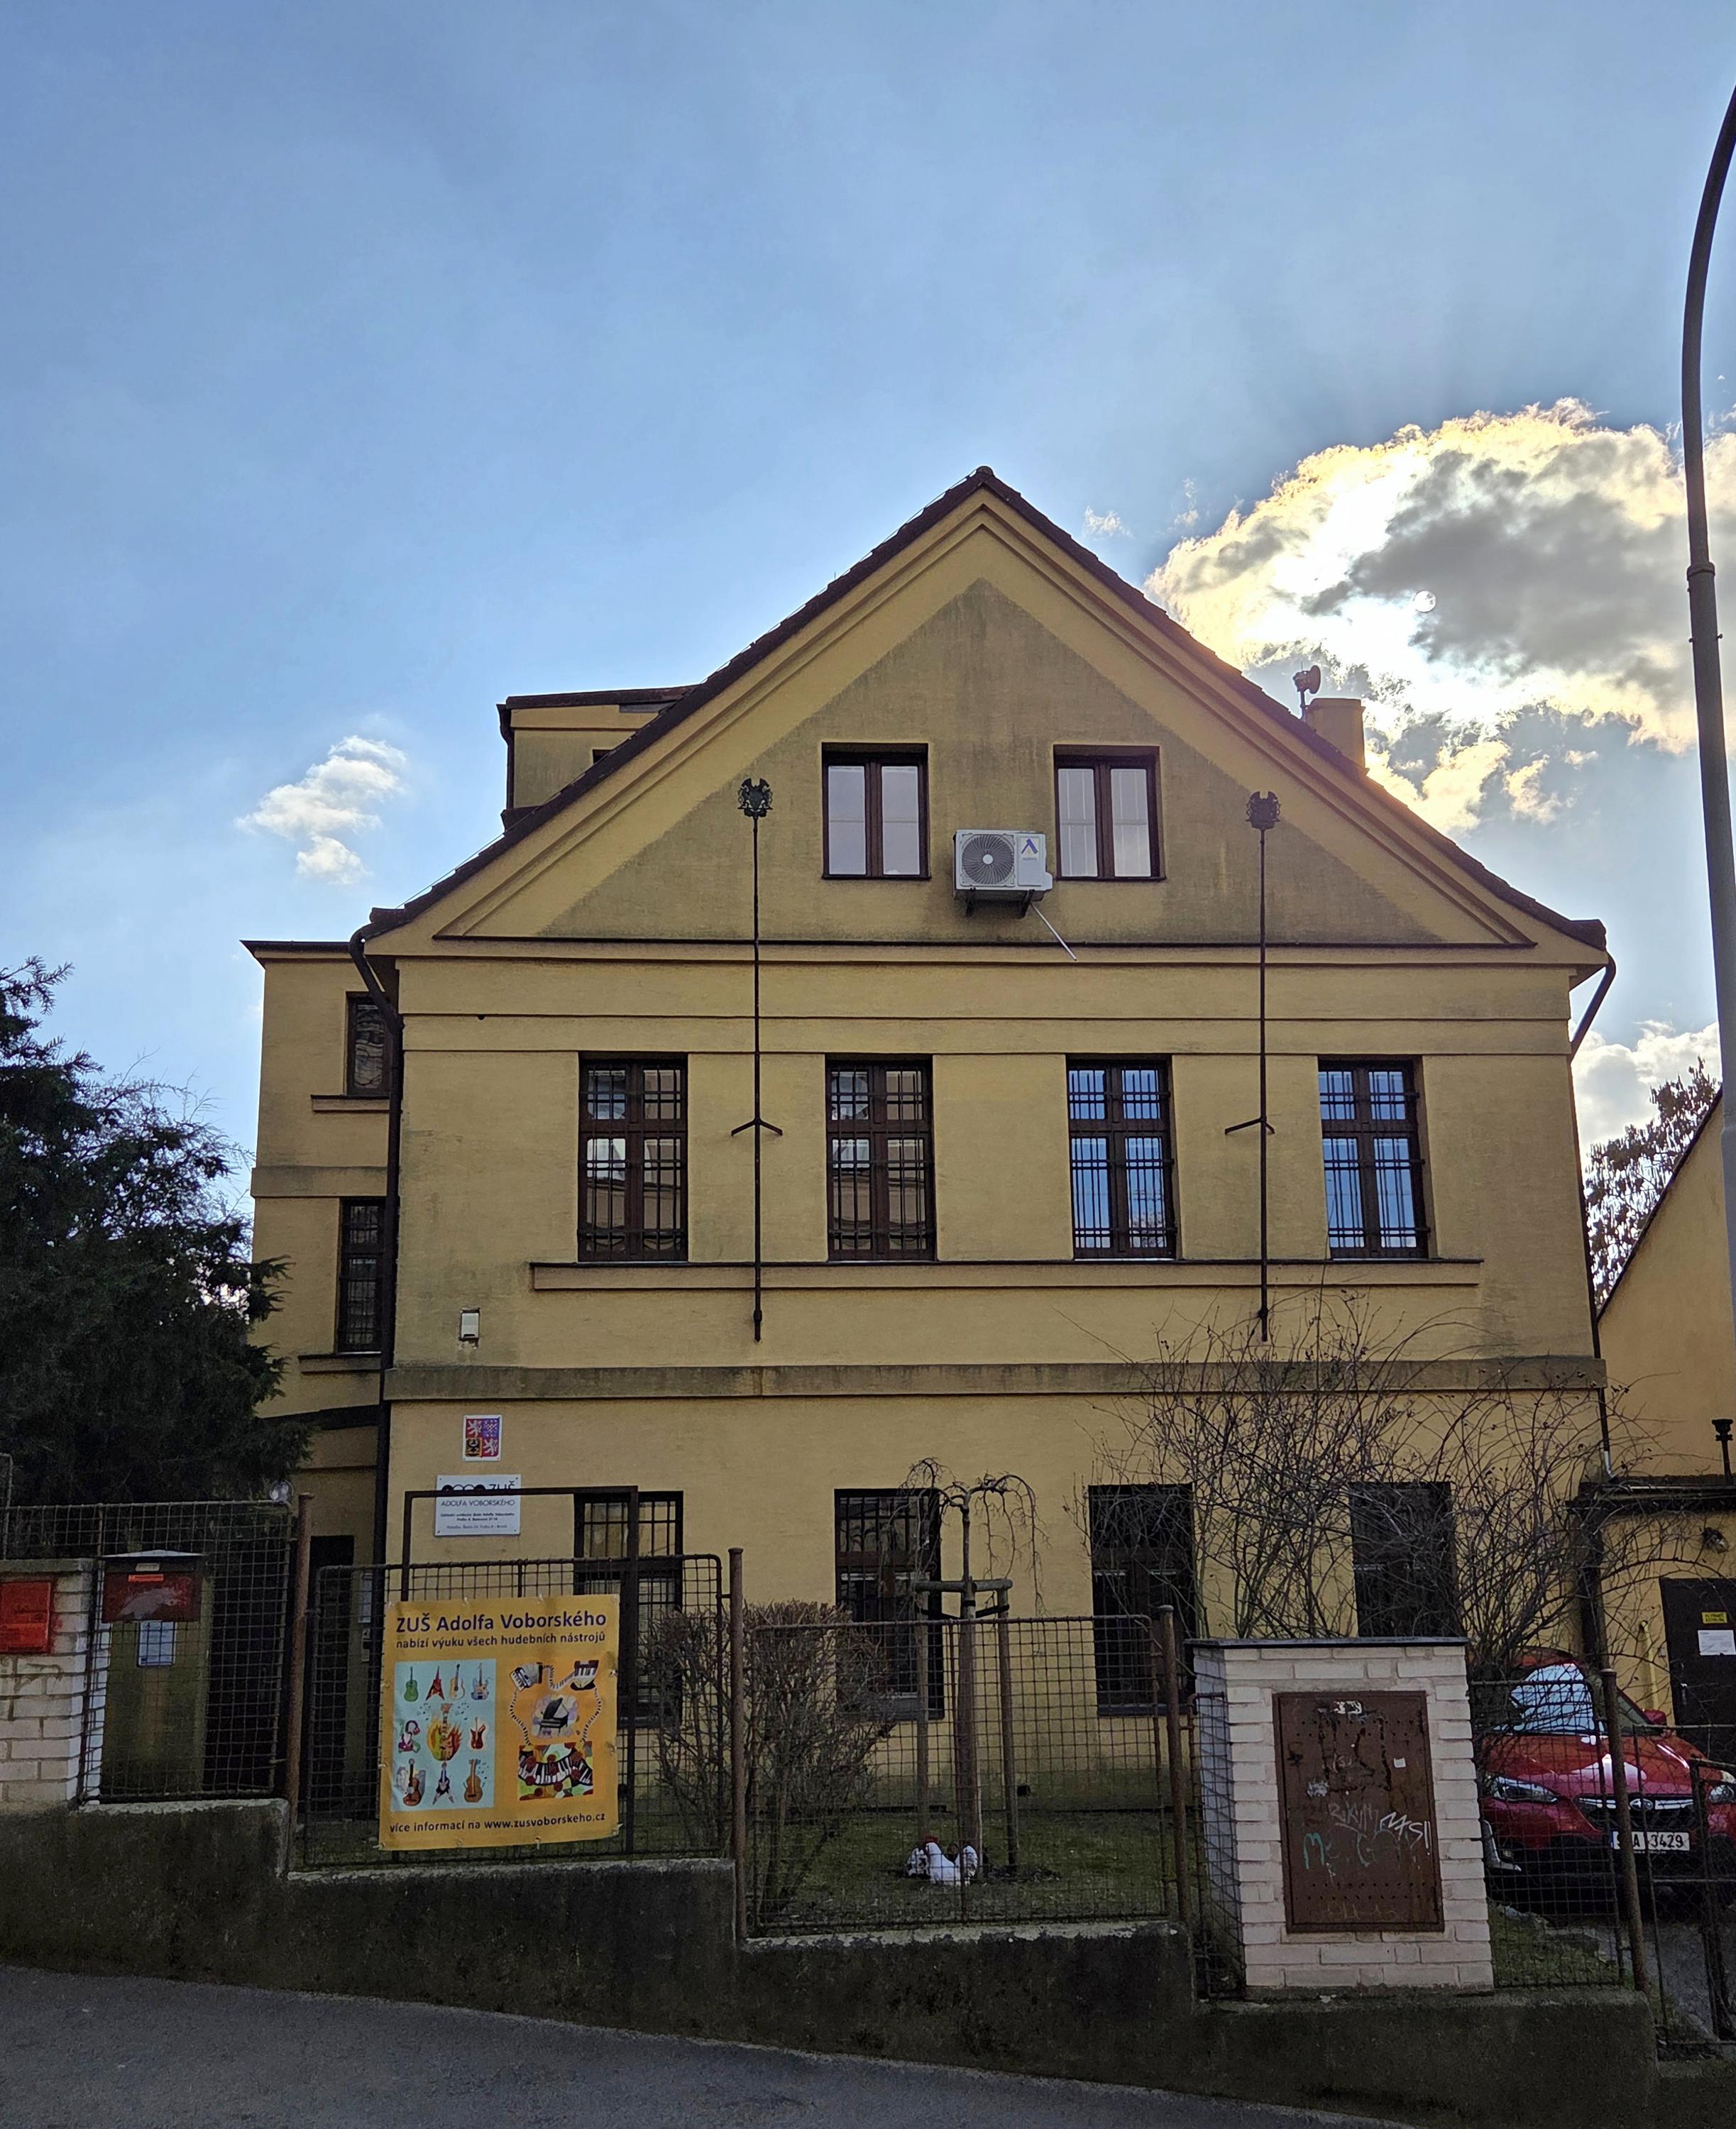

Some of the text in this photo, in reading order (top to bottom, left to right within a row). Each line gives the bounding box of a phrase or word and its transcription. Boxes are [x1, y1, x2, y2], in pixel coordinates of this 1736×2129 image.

[396, 1610, 606, 1633] ZUŠ Adolfa Voborského
[396, 1632, 605, 1650] nabízí výuku všech hudebních nástrojů
[390, 1822, 410, 1833] více
[414, 1820, 465, 1832] informací
[484, 1812, 605, 1829] www.zusvoborskeho.cz
[1650, 1834, 1684, 1848] 3429
